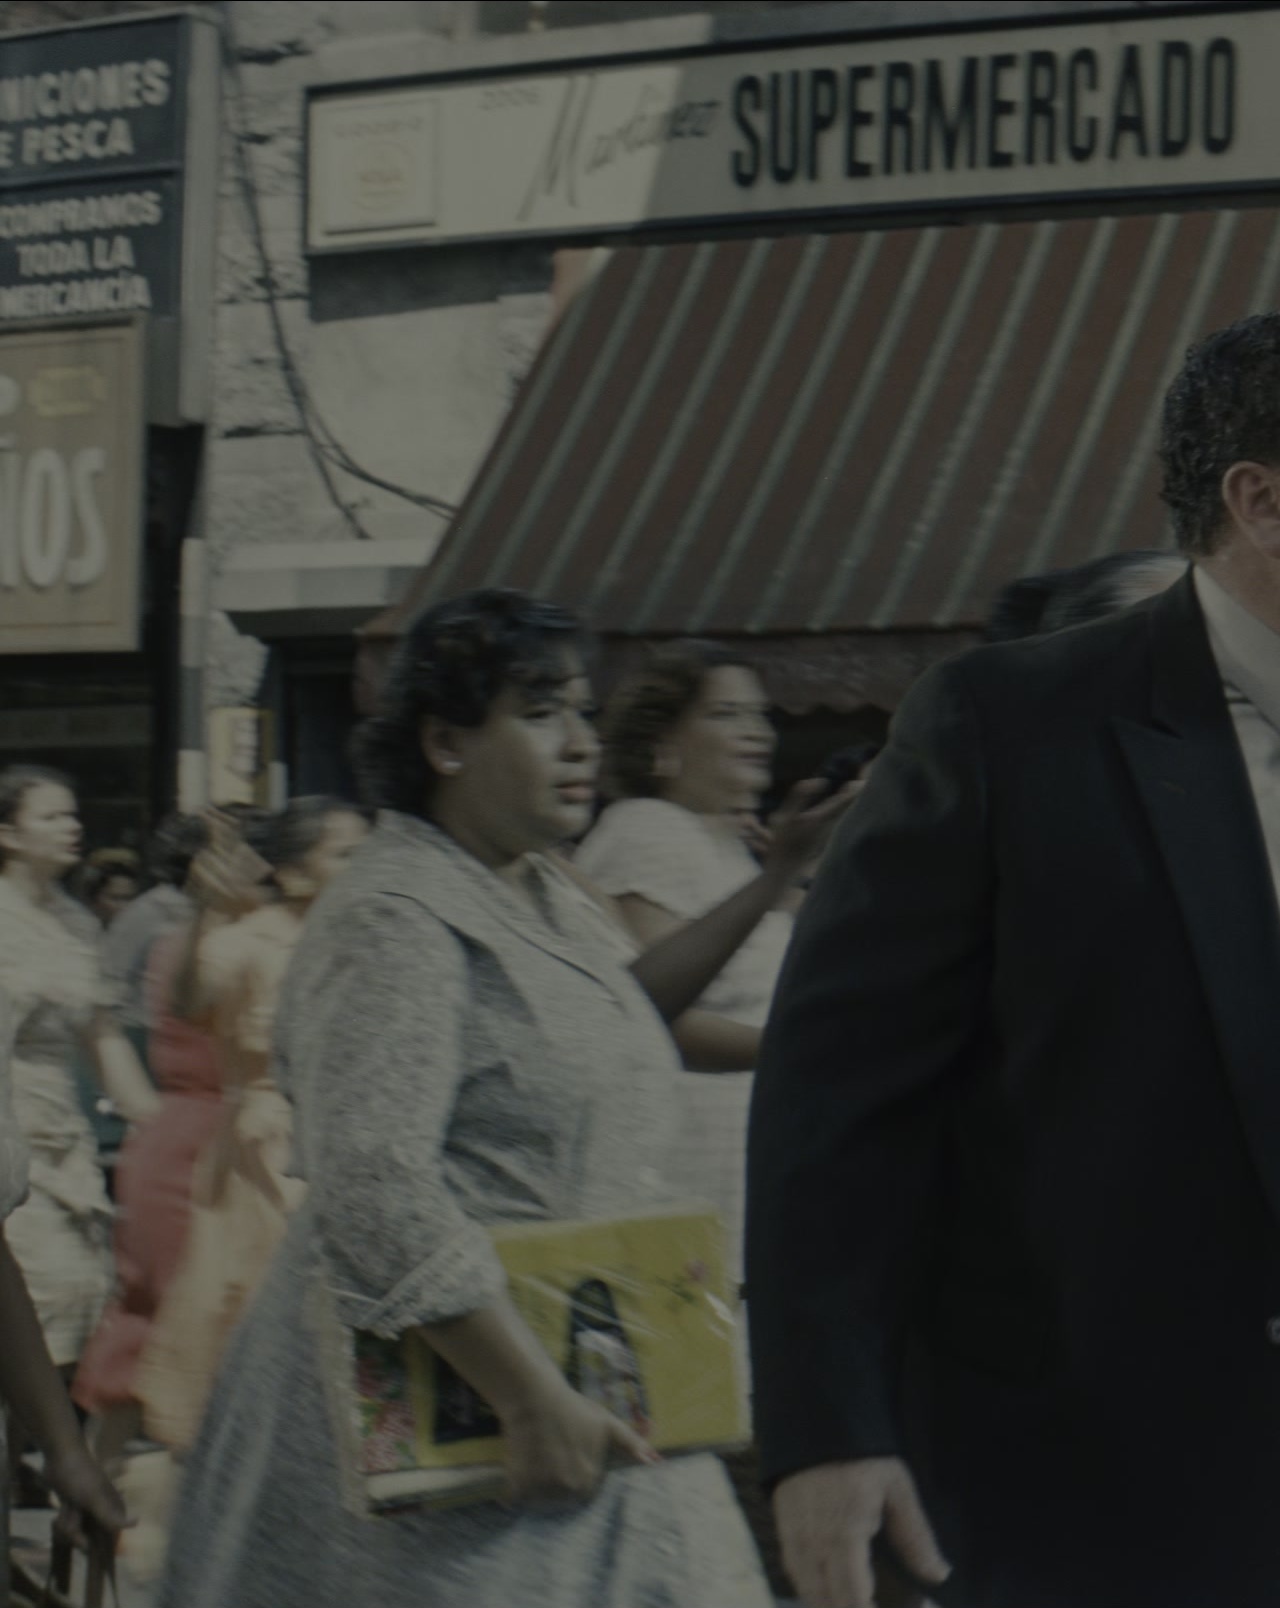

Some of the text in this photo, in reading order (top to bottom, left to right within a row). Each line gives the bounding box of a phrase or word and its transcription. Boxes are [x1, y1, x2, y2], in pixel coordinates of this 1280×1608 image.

[732, 37, 1236, 188] SUPERMERCADO
[22, 118, 134, 165] PESCA
[16, 234, 135, 277] TODA LA
